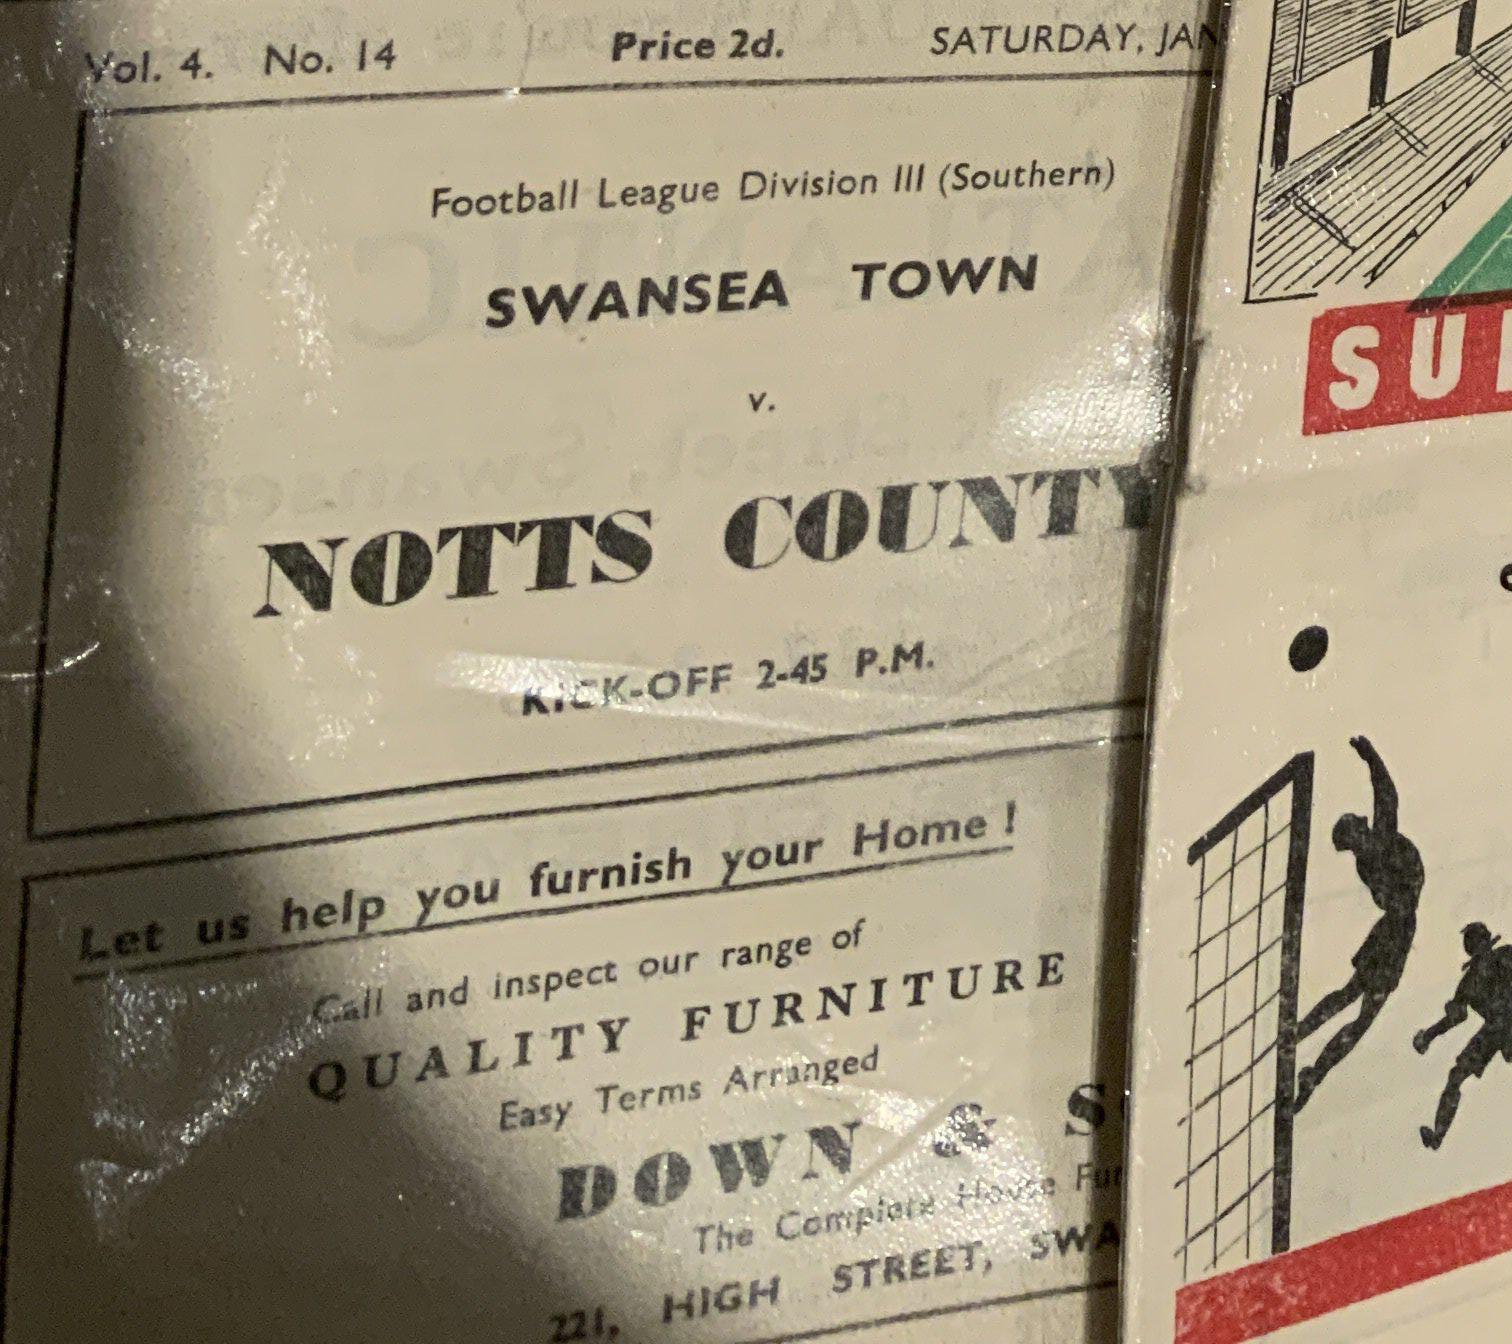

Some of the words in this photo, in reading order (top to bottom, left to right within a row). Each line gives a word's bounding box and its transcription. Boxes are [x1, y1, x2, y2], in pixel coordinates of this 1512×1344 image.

[85, 51, 162, 84] Vol.
[180, 48, 214, 80] 4.
[264, 43, 334, 76] No.
[358, 38, 397, 72] 14
[612, 29, 715, 62] Price
[729, 28, 784, 60] 2d.
[930, 22, 1144, 56] SATURDAY,
[431, 179, 578, 219] Football
[598, 177, 719, 213] League
[739, 166, 878, 203] Division
[894, 164, 925, 194] III
[939, 157, 1117, 202] (Southern)
[485, 269, 789, 329] SWANSEA
[851, 253, 1039, 303] TOWN
[747, 390, 776, 414] v.
[253, 509, 653, 618] NOTTS
[724, 462, 1158, 570] COUNTY
[756, 653, 829, 690] 2-45
[855, 641, 935, 678] P.M.
[77, 921, 164, 962] Let
[197, 914, 250, 946] us
[280, 889, 385, 934] help
[416, 875, 501, 927] you
[530, 848, 692, 897] furnish
[721, 834, 824, 889] your
[313, 988, 383, 1025] Call
[407, 976, 470, 1013] and
[494, 959, 618, 1005] inspect
[639, 951, 699, 980] our
[721, 934, 812, 974] range
[832, 918, 866, 949] of
[308, 1016, 631, 1103] QUALITY
[680, 951, 1068, 1042] FURNITURE
[499, 1097, 574, 1134] Easy
[594, 1080, 703, 1115] Terms
[724, 1045, 880, 1096] Arranged
[557, 1120, 863, 1223] DOWN
[932, 1102, 998, 1159] &
[695, 1222, 754, 1255] The
[662, 1275, 781, 1324] HIGH
[832, 1241, 993, 1294] STREET,
